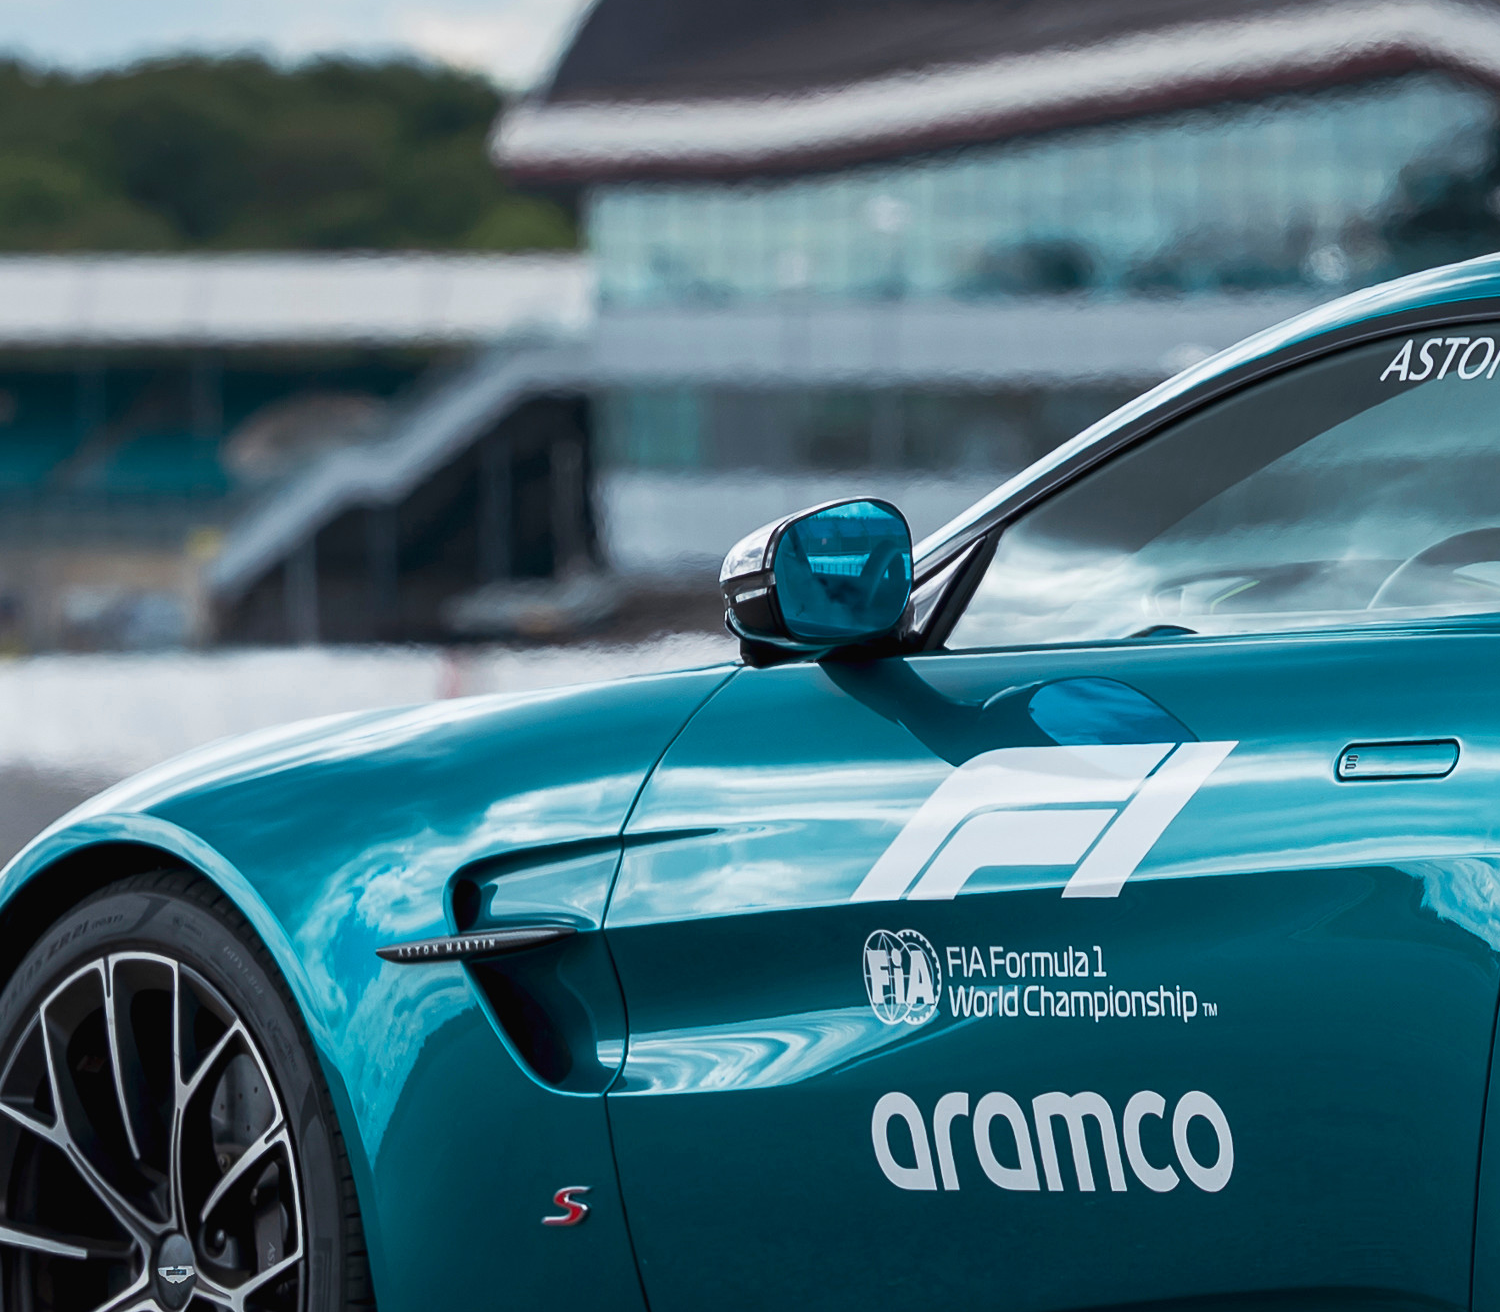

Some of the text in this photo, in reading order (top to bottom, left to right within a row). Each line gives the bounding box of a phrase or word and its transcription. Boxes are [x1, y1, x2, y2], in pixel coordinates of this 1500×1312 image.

[849, 740, 1240, 901] F1
[398, 938, 496, 958] ASTON MARTIN
[946, 945, 1107, 978] FIA Formula 1
[948, 985, 1020, 1018] World
[1023, 985, 1198, 1023] Championship
[870, 1089, 1235, 1193] aramco
[540, 1184, 594, 1227] S
